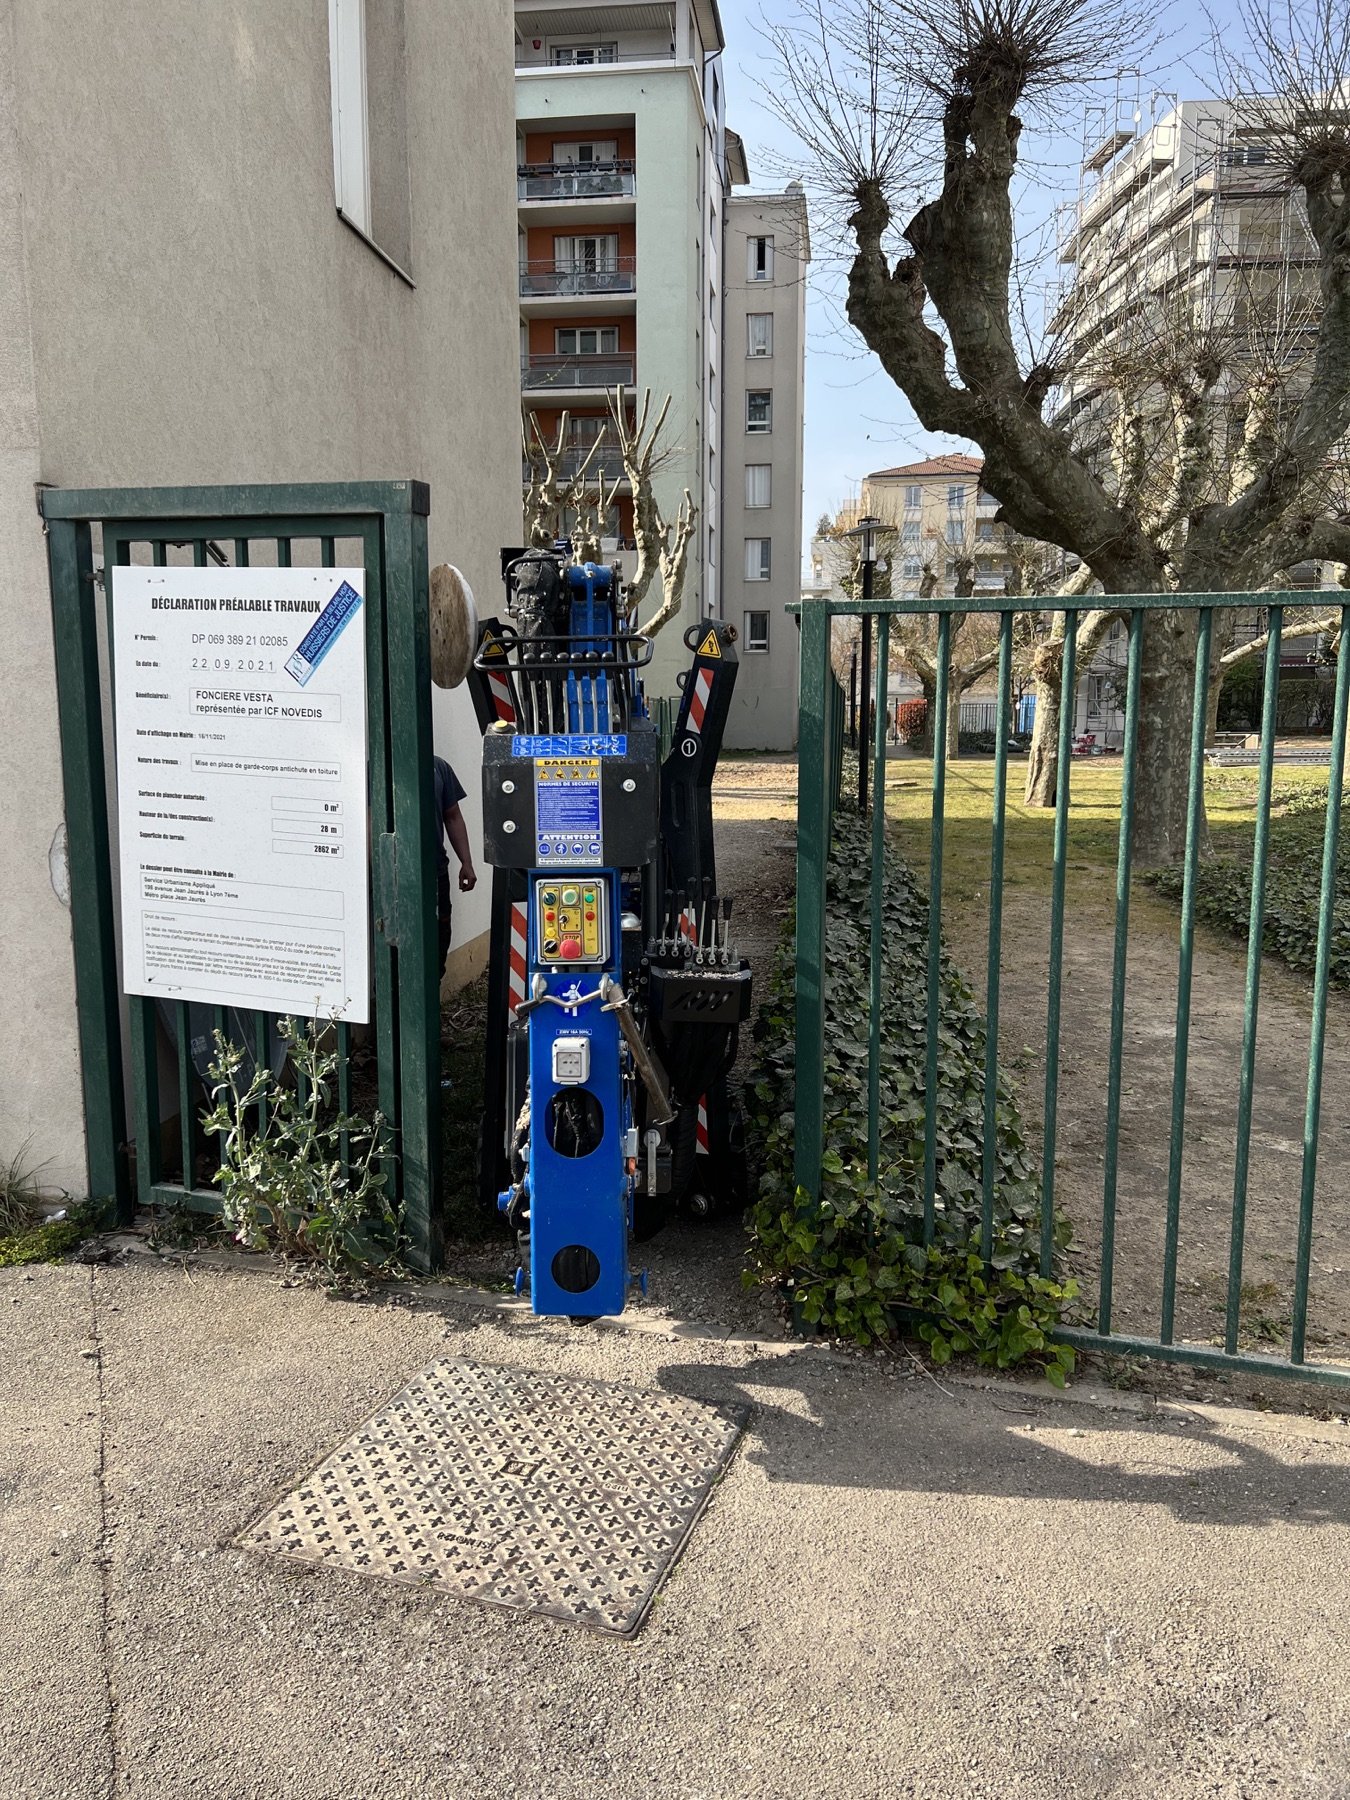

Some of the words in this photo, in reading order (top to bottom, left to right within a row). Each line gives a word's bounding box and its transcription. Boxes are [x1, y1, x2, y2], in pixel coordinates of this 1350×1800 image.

[152, 595, 216, 610] DÉCLARATION
[220, 596, 271, 611] PRÉALABLE
[276, 597, 320, 613] TRAVAUX
[304, 625, 331, 661] HUISSIERS
[326, 615, 338, 629] DE
[333, 589, 356, 619] JUSTICE
[316, 618, 326, 631] PAR
[322, 613, 330, 621] LA
[192, 634, 205, 644] DP
[208, 634, 224, 644] 069
[228, 635, 243, 645] 389
[246, 636, 256, 645] 21
[260, 636, 288, 646] 02085
[196, 691, 241, 701] FONCIERE
[244, 693, 273, 702] VESTA
[196, 705, 245, 714] représentée
[265, 707, 278, 716] ICF
[282, 708, 322, 718] NOVEDIS
[686, 742, 691, 754] 1
